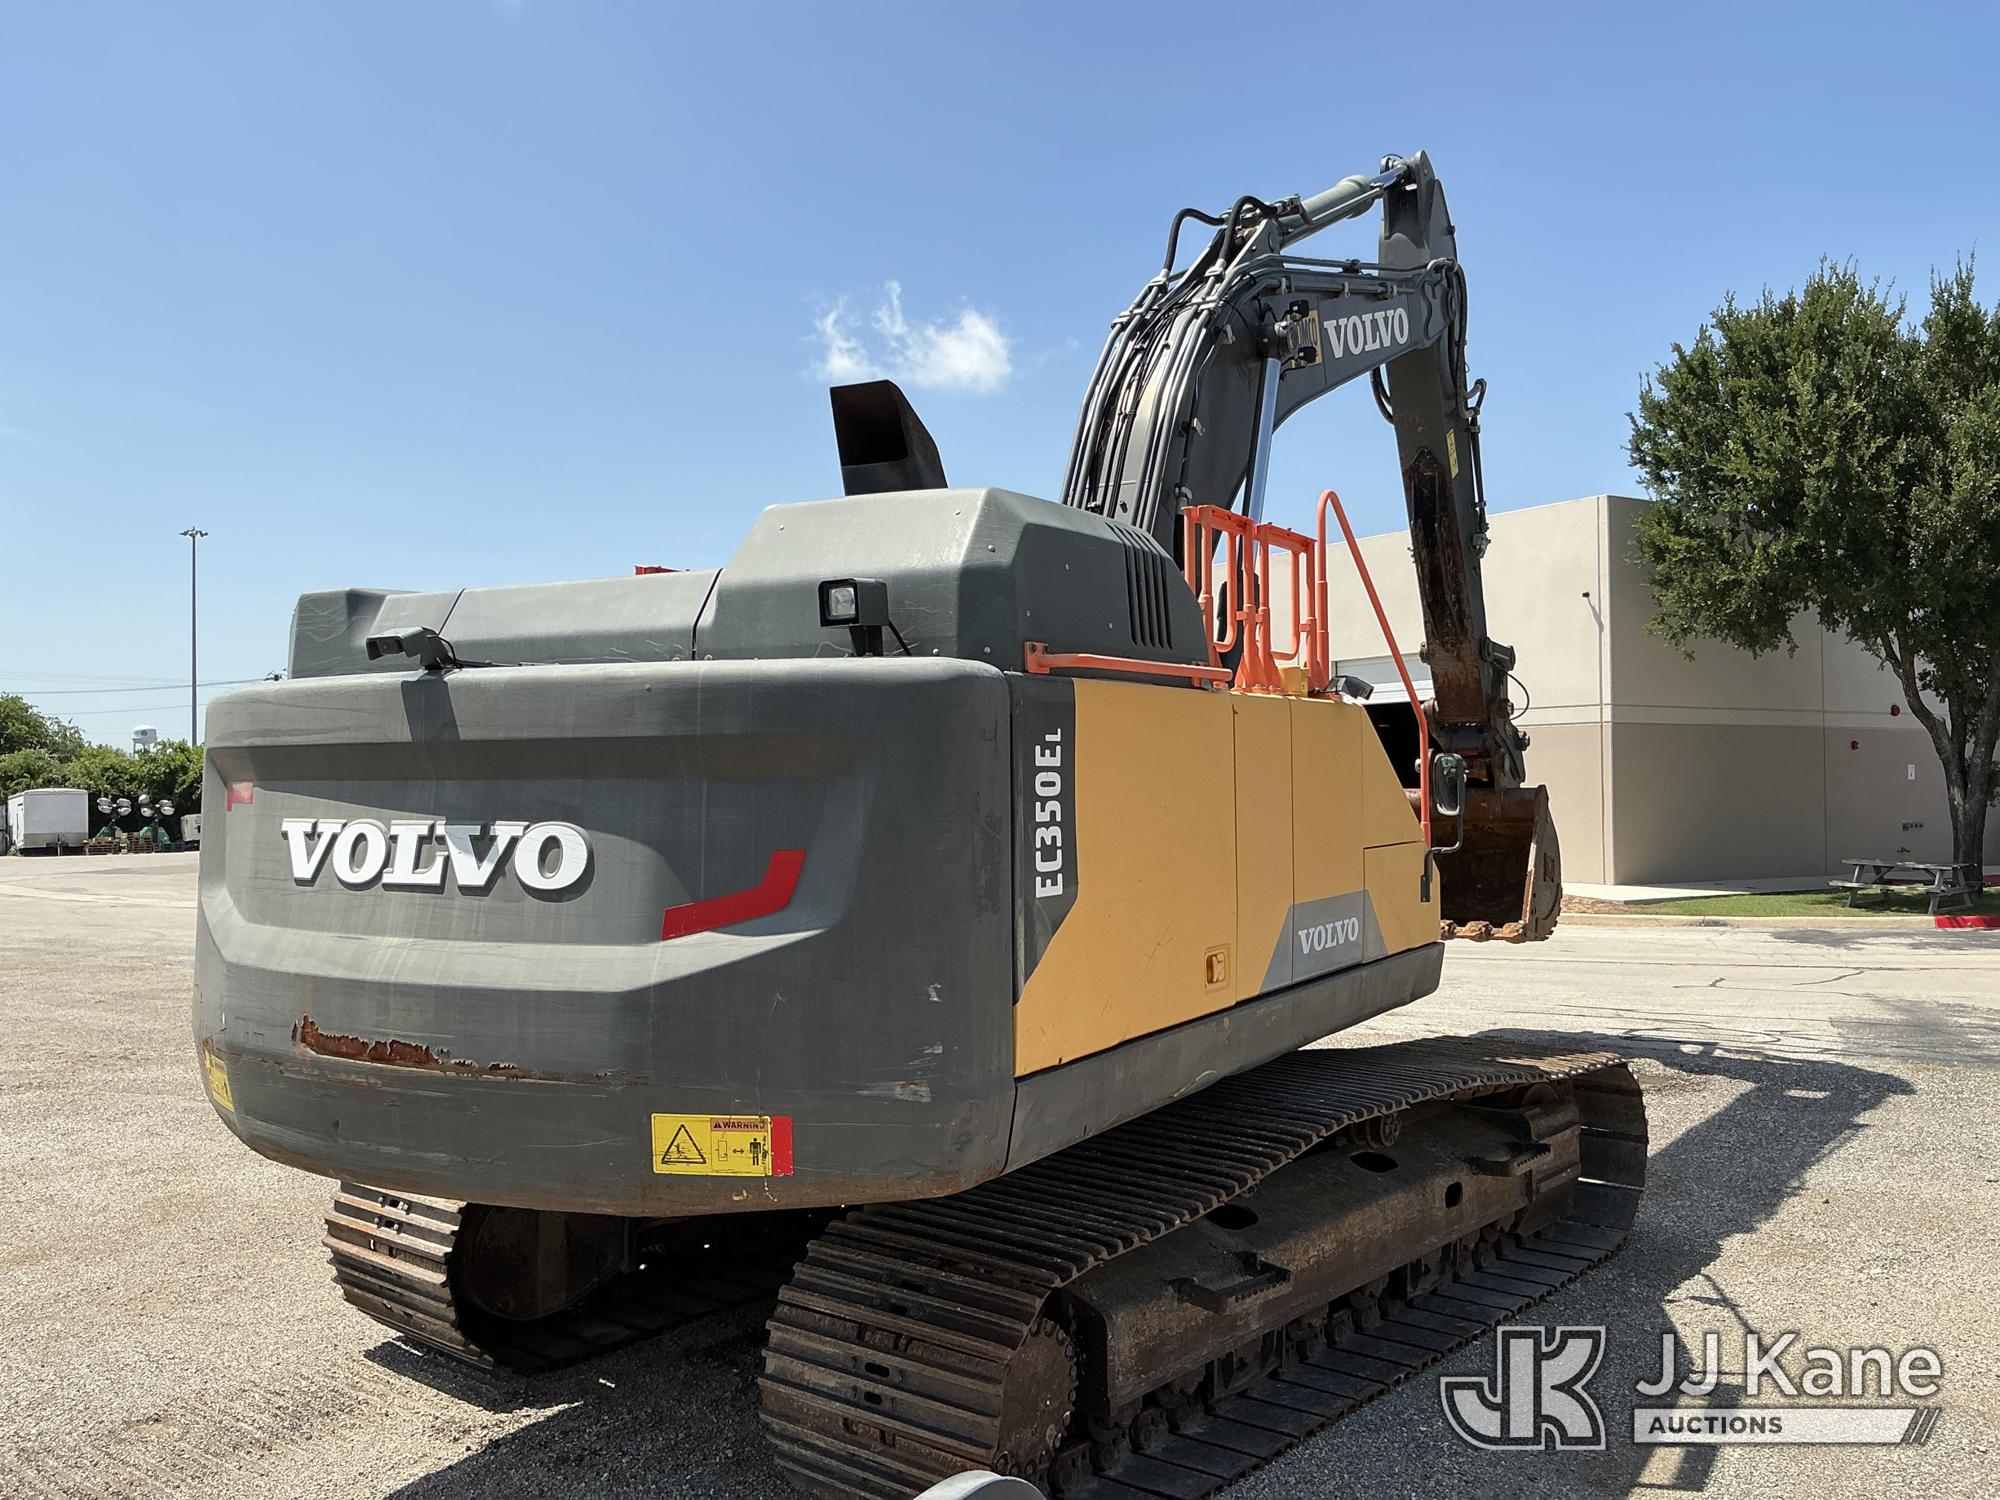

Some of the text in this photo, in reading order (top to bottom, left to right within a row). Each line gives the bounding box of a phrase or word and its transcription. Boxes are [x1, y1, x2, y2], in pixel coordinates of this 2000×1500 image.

[1323, 307, 1409, 359] VOLVO
[1035, 728, 1063, 898] EC350EL
[281, 817, 590, 894] VOLVO
[1298, 916, 1359, 955] VOLVO
